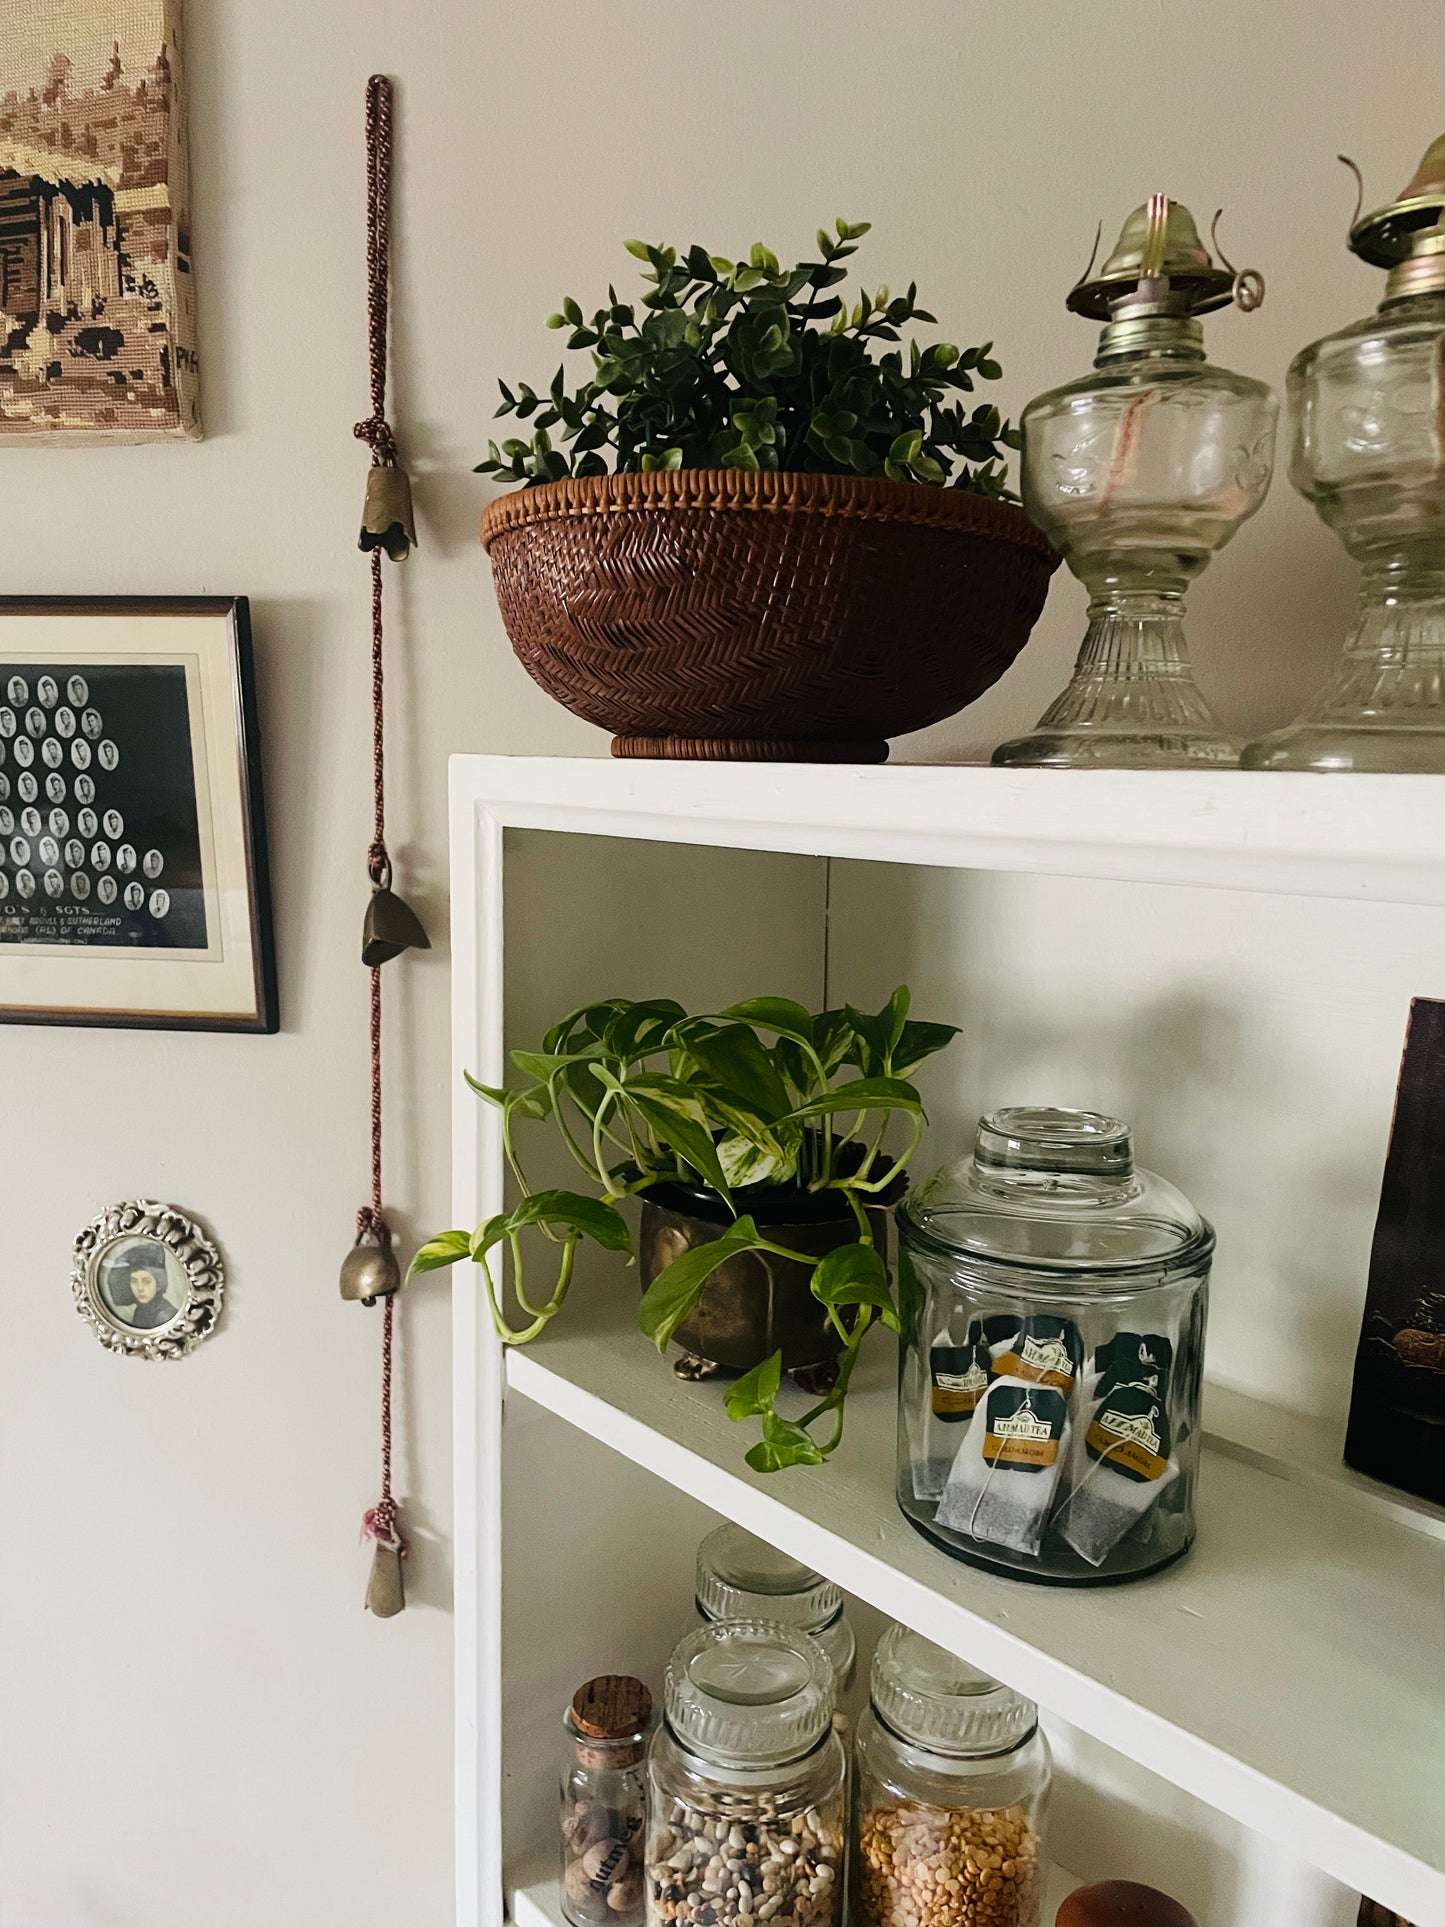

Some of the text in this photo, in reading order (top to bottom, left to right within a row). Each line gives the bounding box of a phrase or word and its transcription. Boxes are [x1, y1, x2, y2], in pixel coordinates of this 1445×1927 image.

[67, 917, 122, 926] SUTHERLAND
[77, 927, 116, 936] CANADA
[997, 1423, 1030, 1434] AHMAD
[1031, 1425, 1048, 1436] TEA
